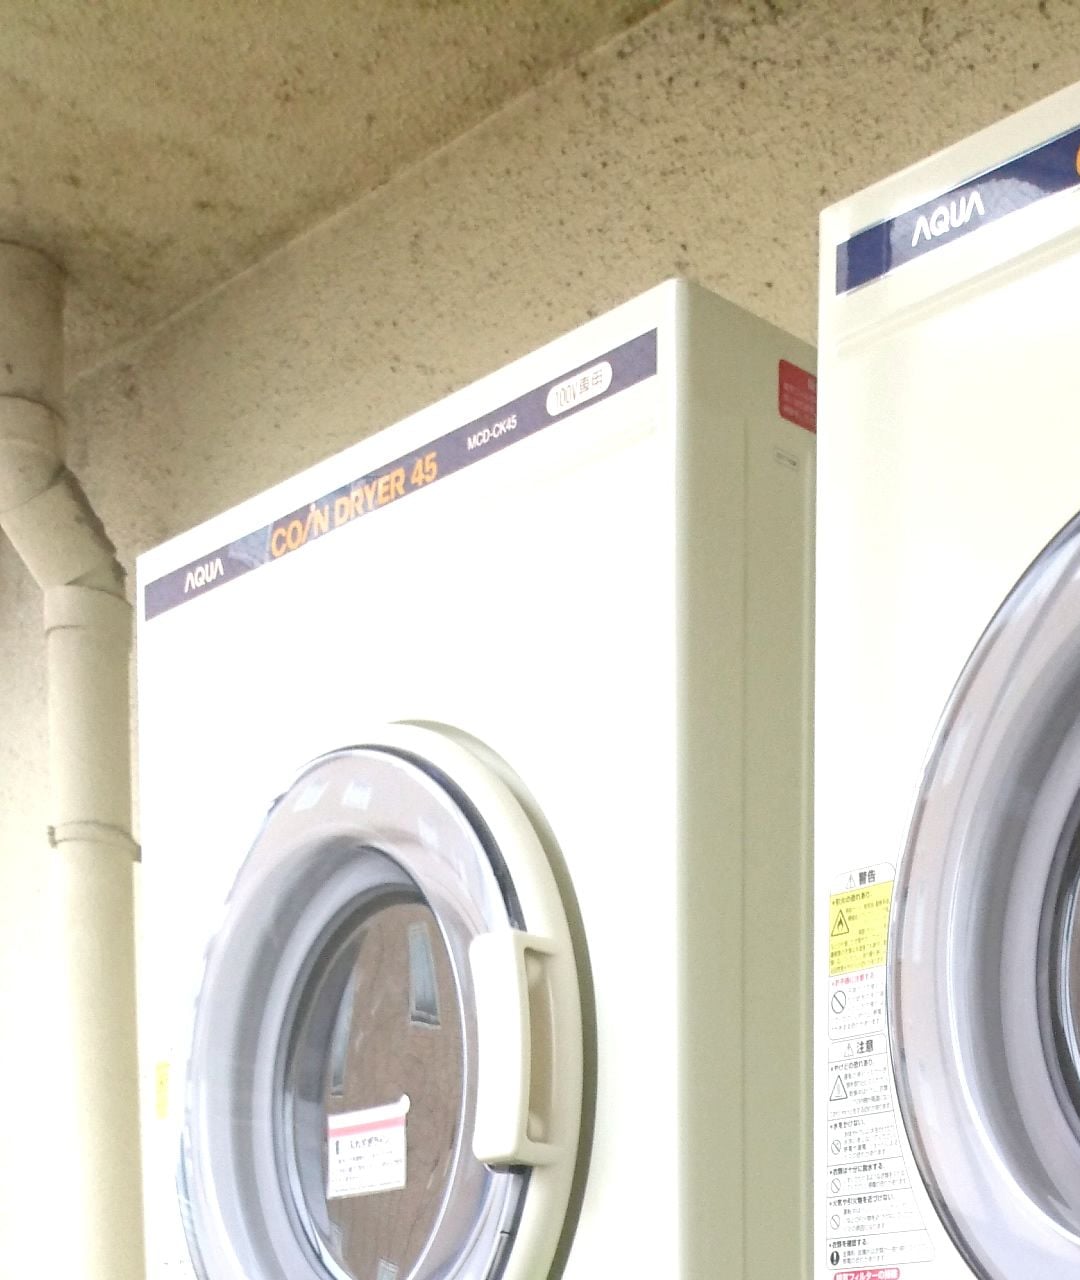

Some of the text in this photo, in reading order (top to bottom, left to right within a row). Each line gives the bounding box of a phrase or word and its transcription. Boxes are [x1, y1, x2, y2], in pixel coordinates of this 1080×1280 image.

[912, 191, 984, 247] AQUA
[185, 558, 224, 592] AQUA
[335, 473, 405, 529] DRYER
[411, 452, 438, 486] 45
